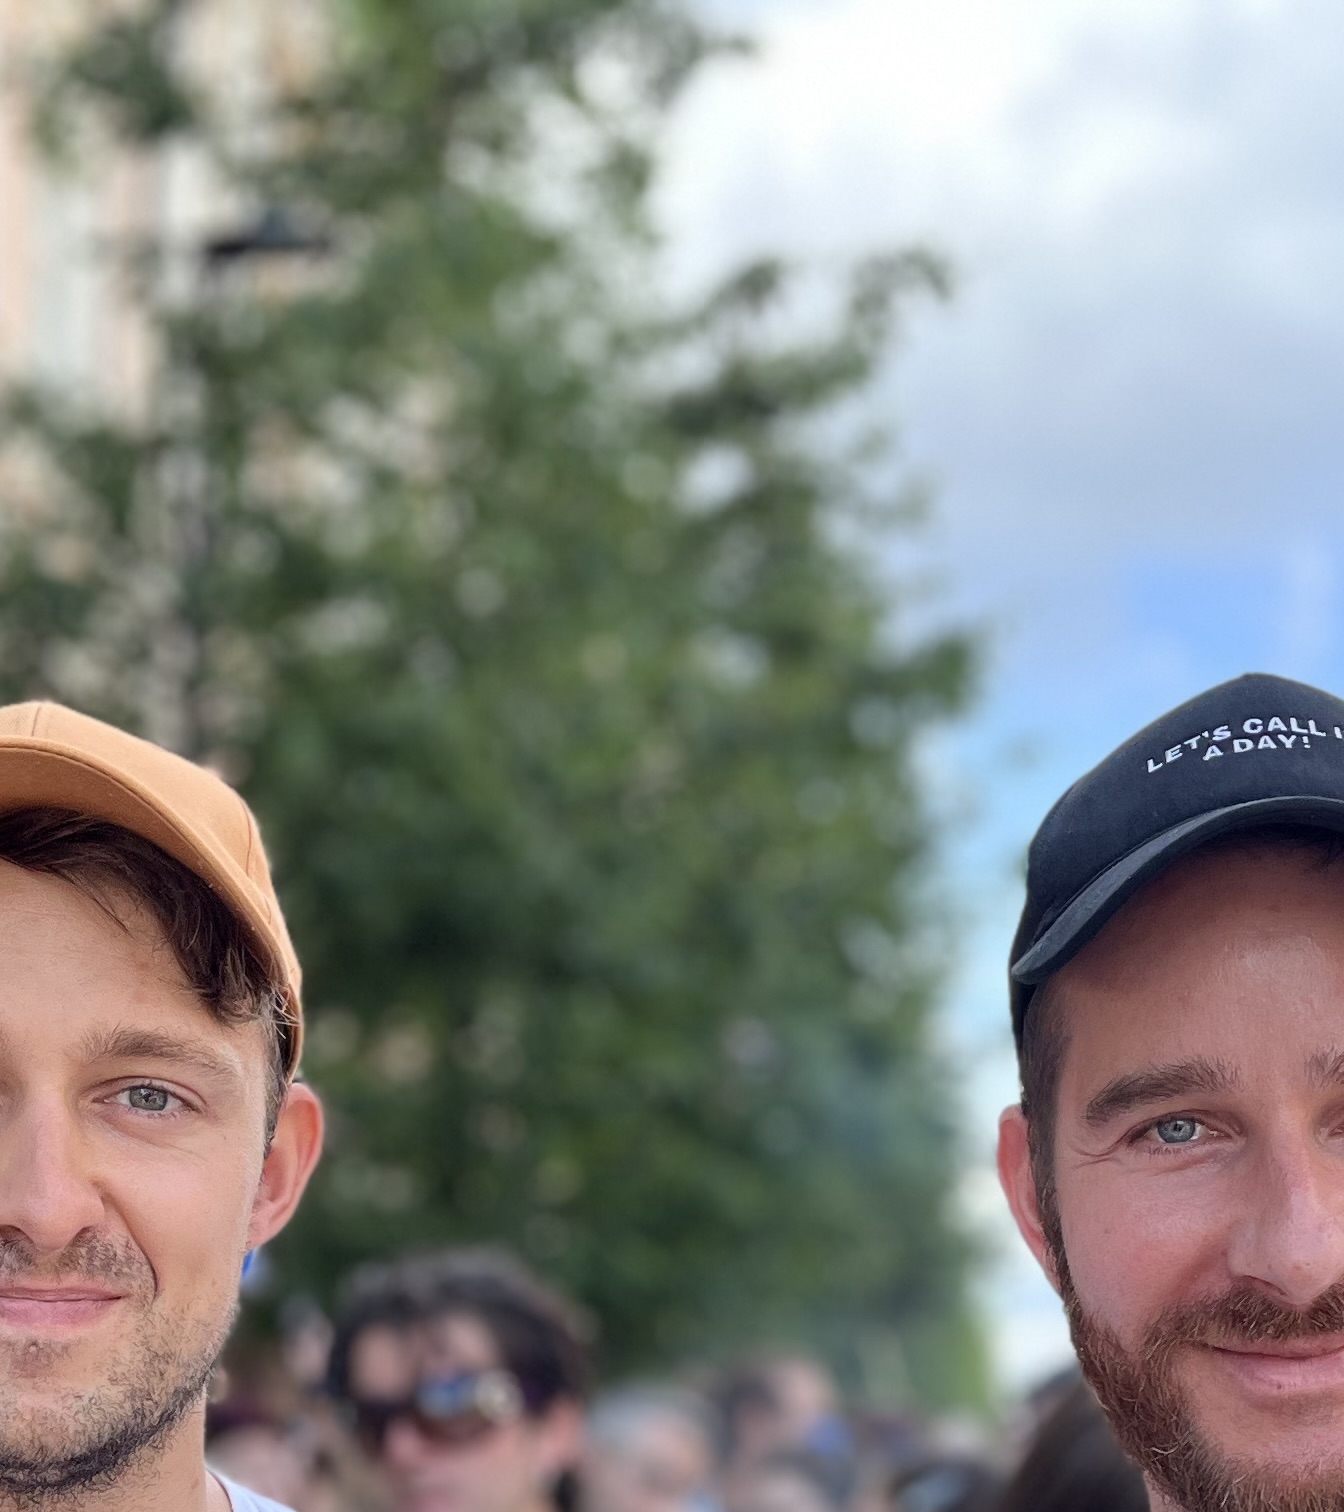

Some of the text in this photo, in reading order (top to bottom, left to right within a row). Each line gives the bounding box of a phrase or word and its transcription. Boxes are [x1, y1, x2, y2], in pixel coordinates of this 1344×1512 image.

[1146, 724, 1232, 774] LET'S
[1242, 716, 1327, 738] CALL
[1202, 734, 1312, 761] A DAY!
